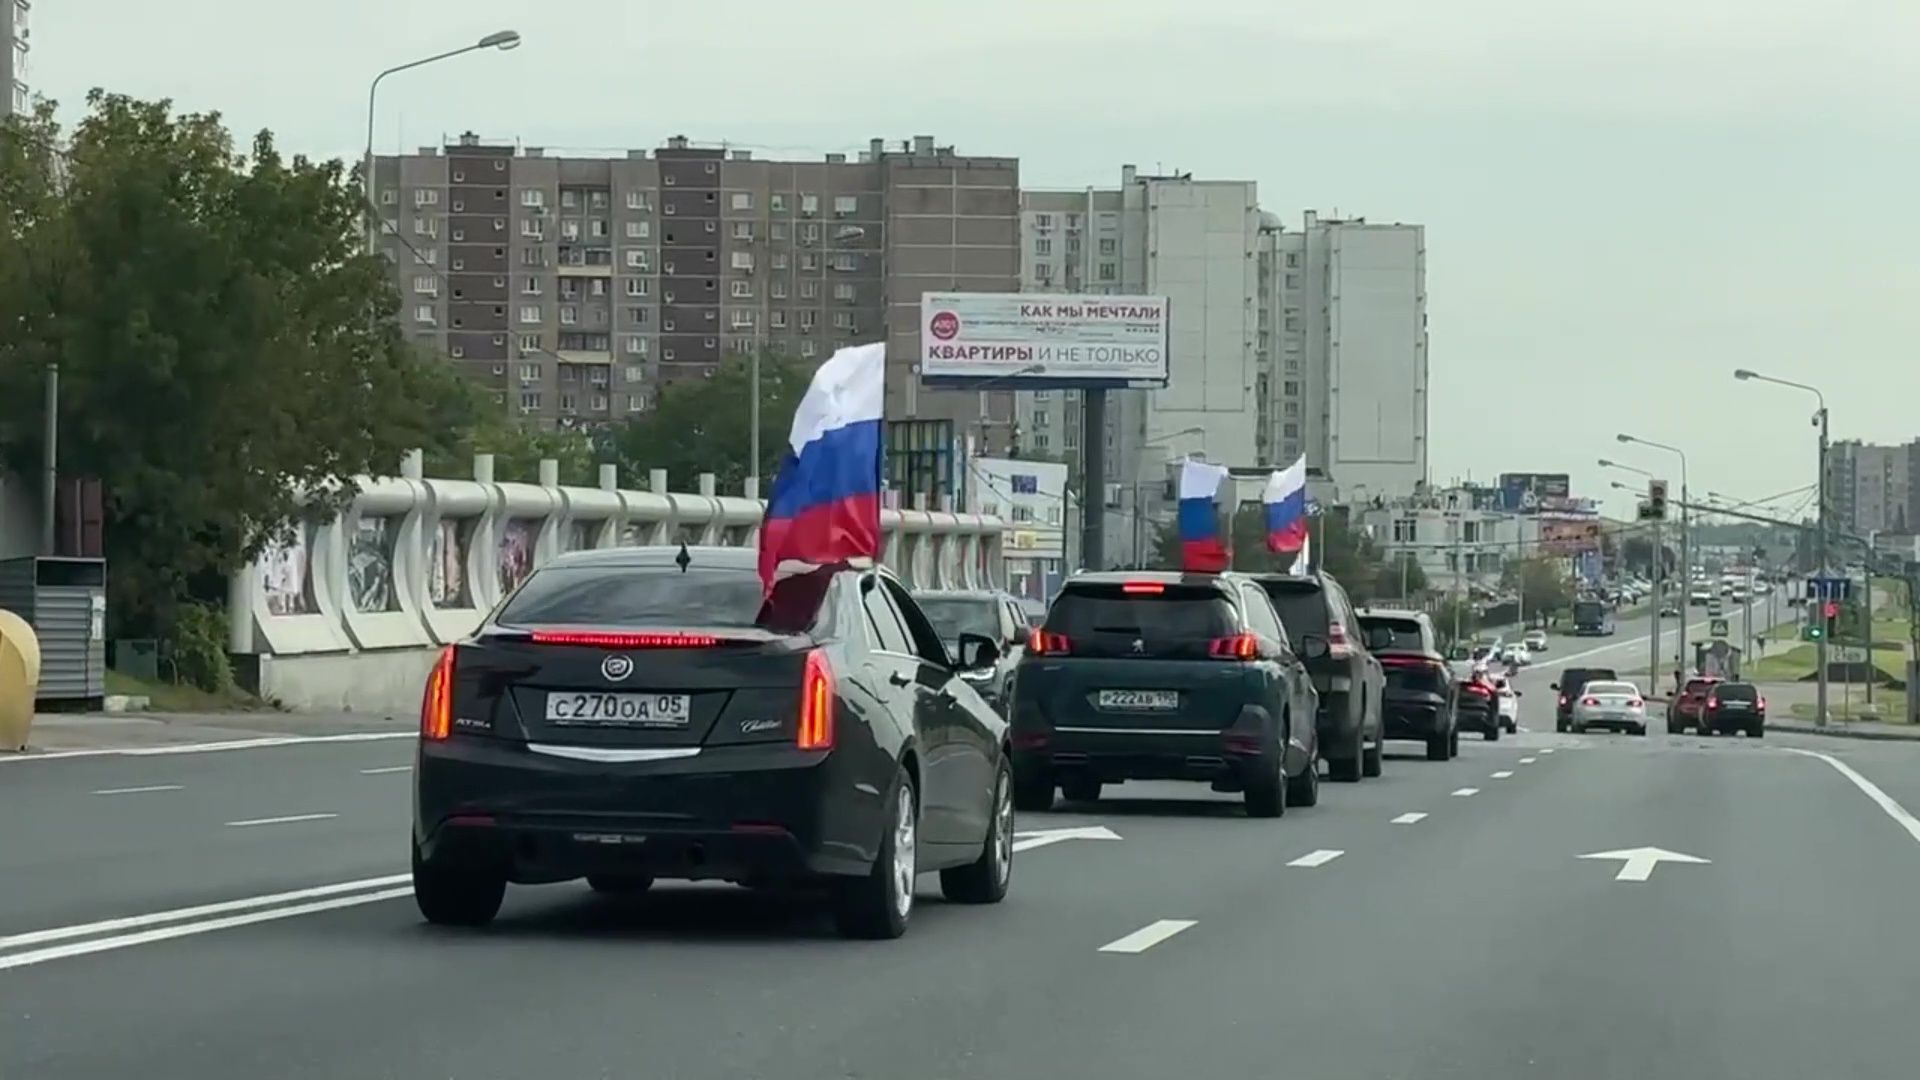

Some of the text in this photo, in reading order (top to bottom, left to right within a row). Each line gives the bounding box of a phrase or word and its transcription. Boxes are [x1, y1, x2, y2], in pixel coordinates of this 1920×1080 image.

[1020, 305, 1161, 319] КАК МЫ МЕЧТАЛИ
[928, 345, 1161, 363] КВАРТИРЫ И НЕ ТОЛЬКО
[658, 696, 683, 713] 05
